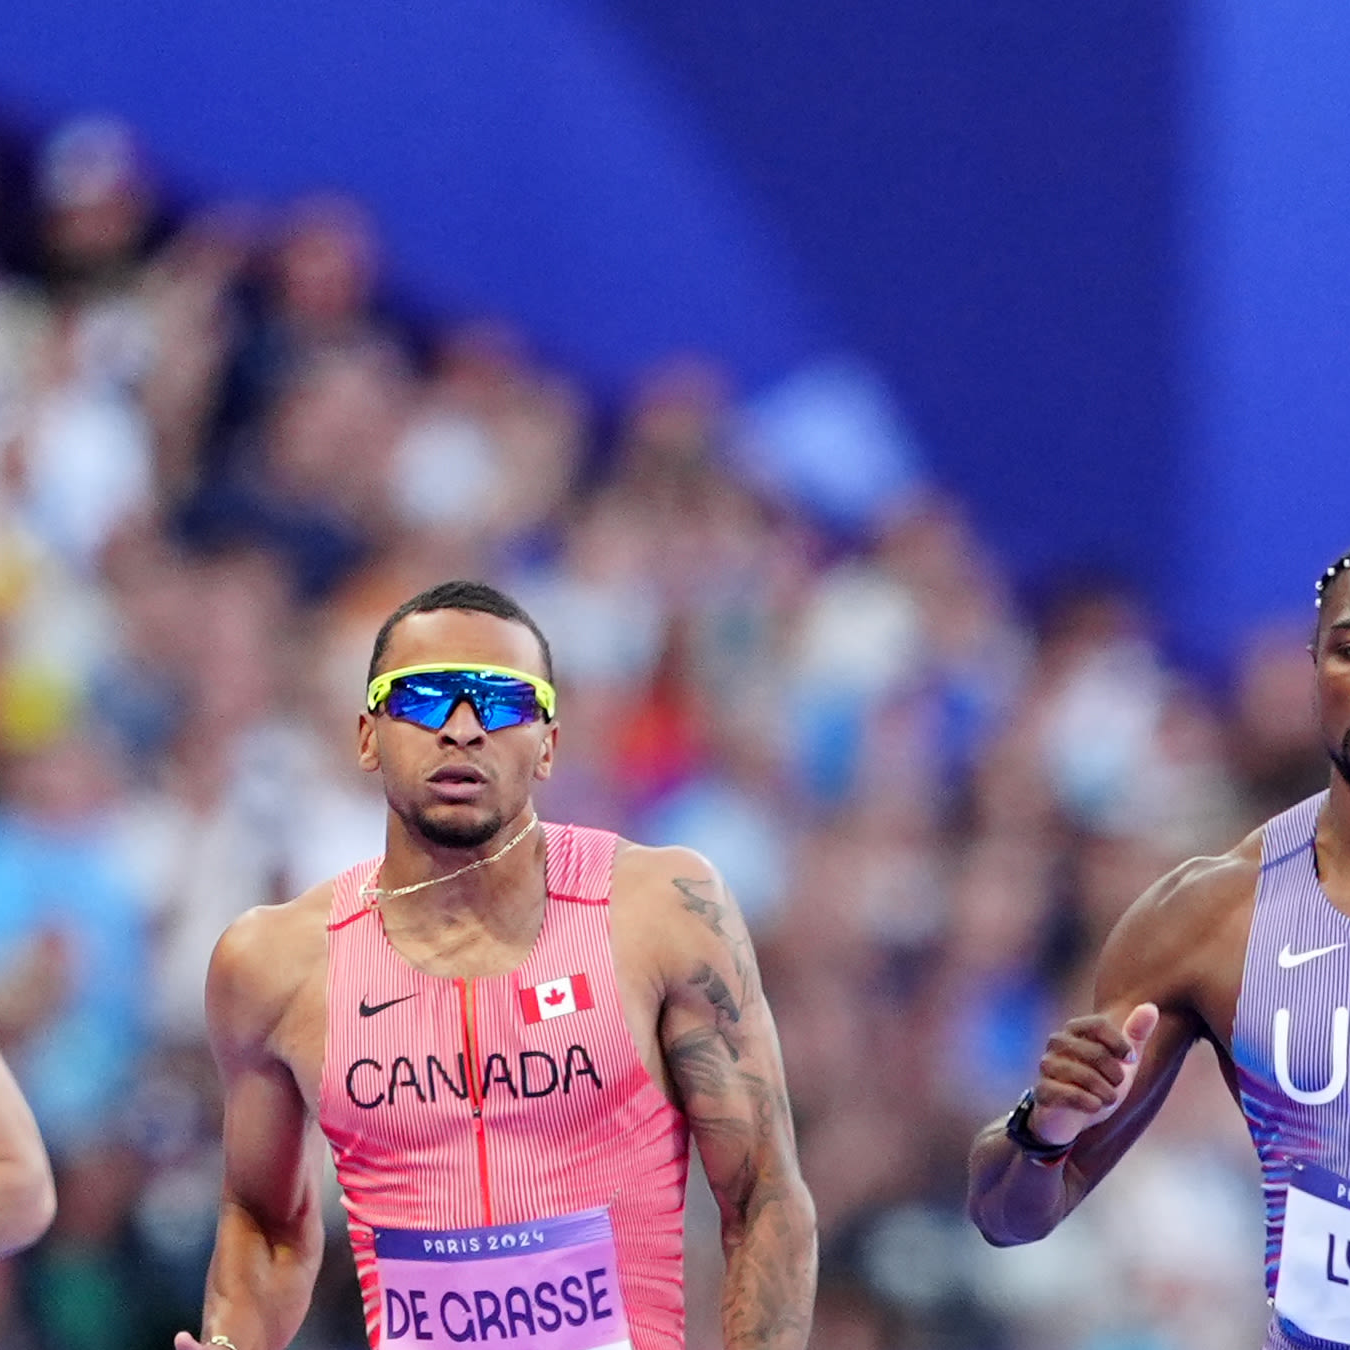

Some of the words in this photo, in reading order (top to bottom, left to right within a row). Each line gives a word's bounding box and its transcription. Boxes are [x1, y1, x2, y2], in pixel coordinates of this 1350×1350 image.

[346, 1045, 602, 1109] CANADA
[423, 1237, 480, 1254] PARIS
[487, 1229, 544, 1251] 2024
[385, 1287, 434, 1341] DE
[439, 1267, 614, 1344] GRASSE
